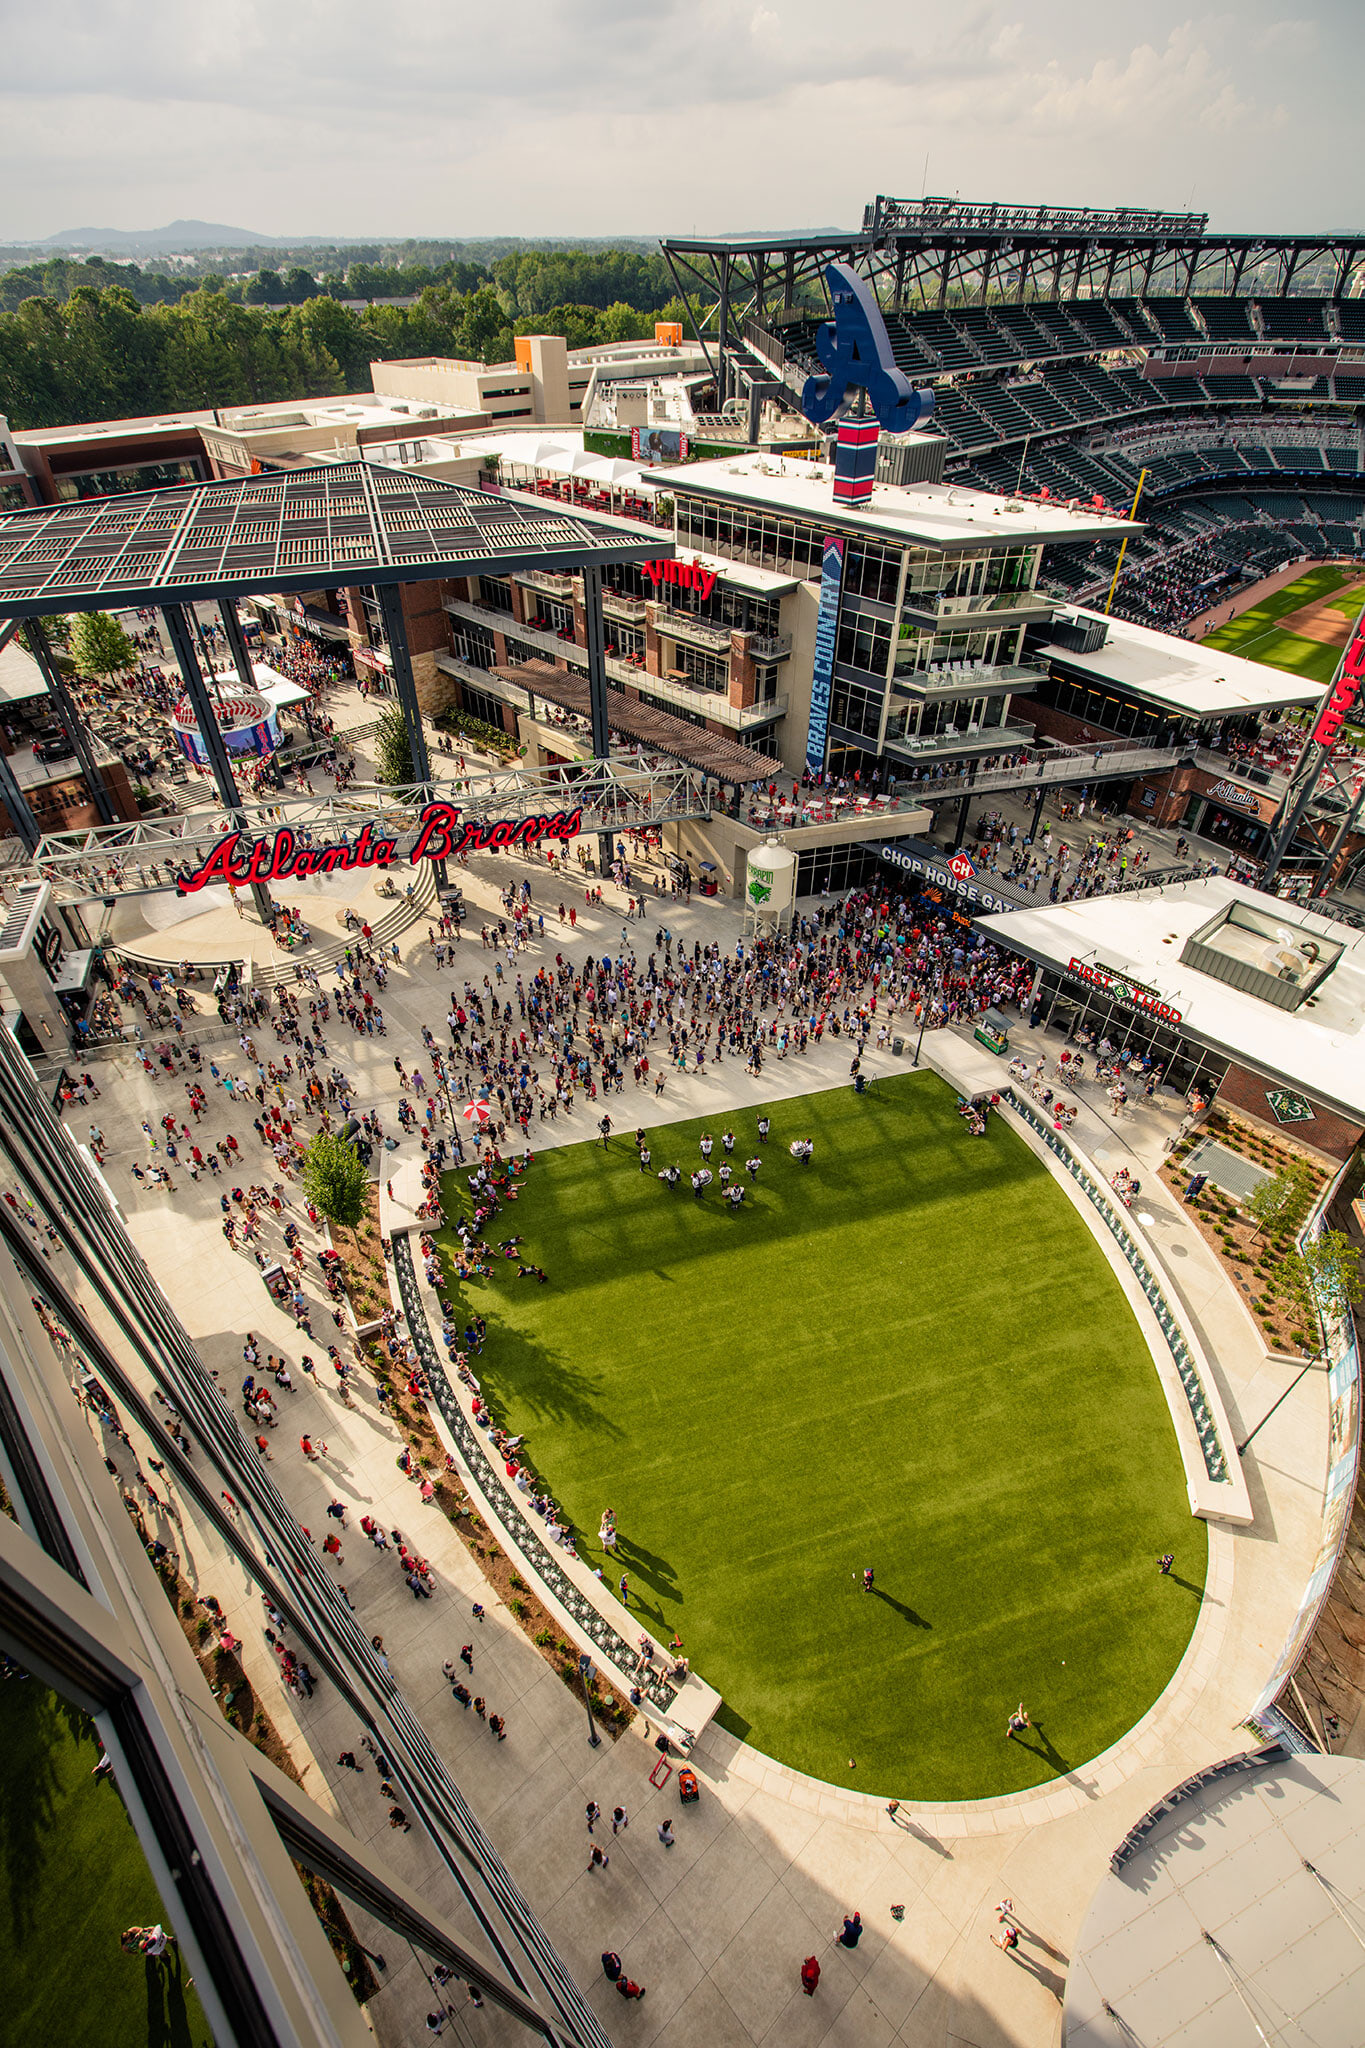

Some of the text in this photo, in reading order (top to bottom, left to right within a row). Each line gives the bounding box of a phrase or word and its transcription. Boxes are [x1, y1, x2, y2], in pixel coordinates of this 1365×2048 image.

[807, 571, 841, 759] BRAVES COUNTRY
[1206, 779, 1256, 806] Atlanta
[176, 800, 584, 893] Atlanta Braves
[881, 845, 1022, 914] CHOP HOUSE GAT
[951, 859, 972, 878] CH
[1063, 970, 1078, 982] HOT
[1080, 979, 1097, 993] DOG
[1099, 989, 1115, 1001] AND
[1154, 1015, 1181, 1034] SHACK
[1068, 956, 1183, 1024] FIRST & THIRD
